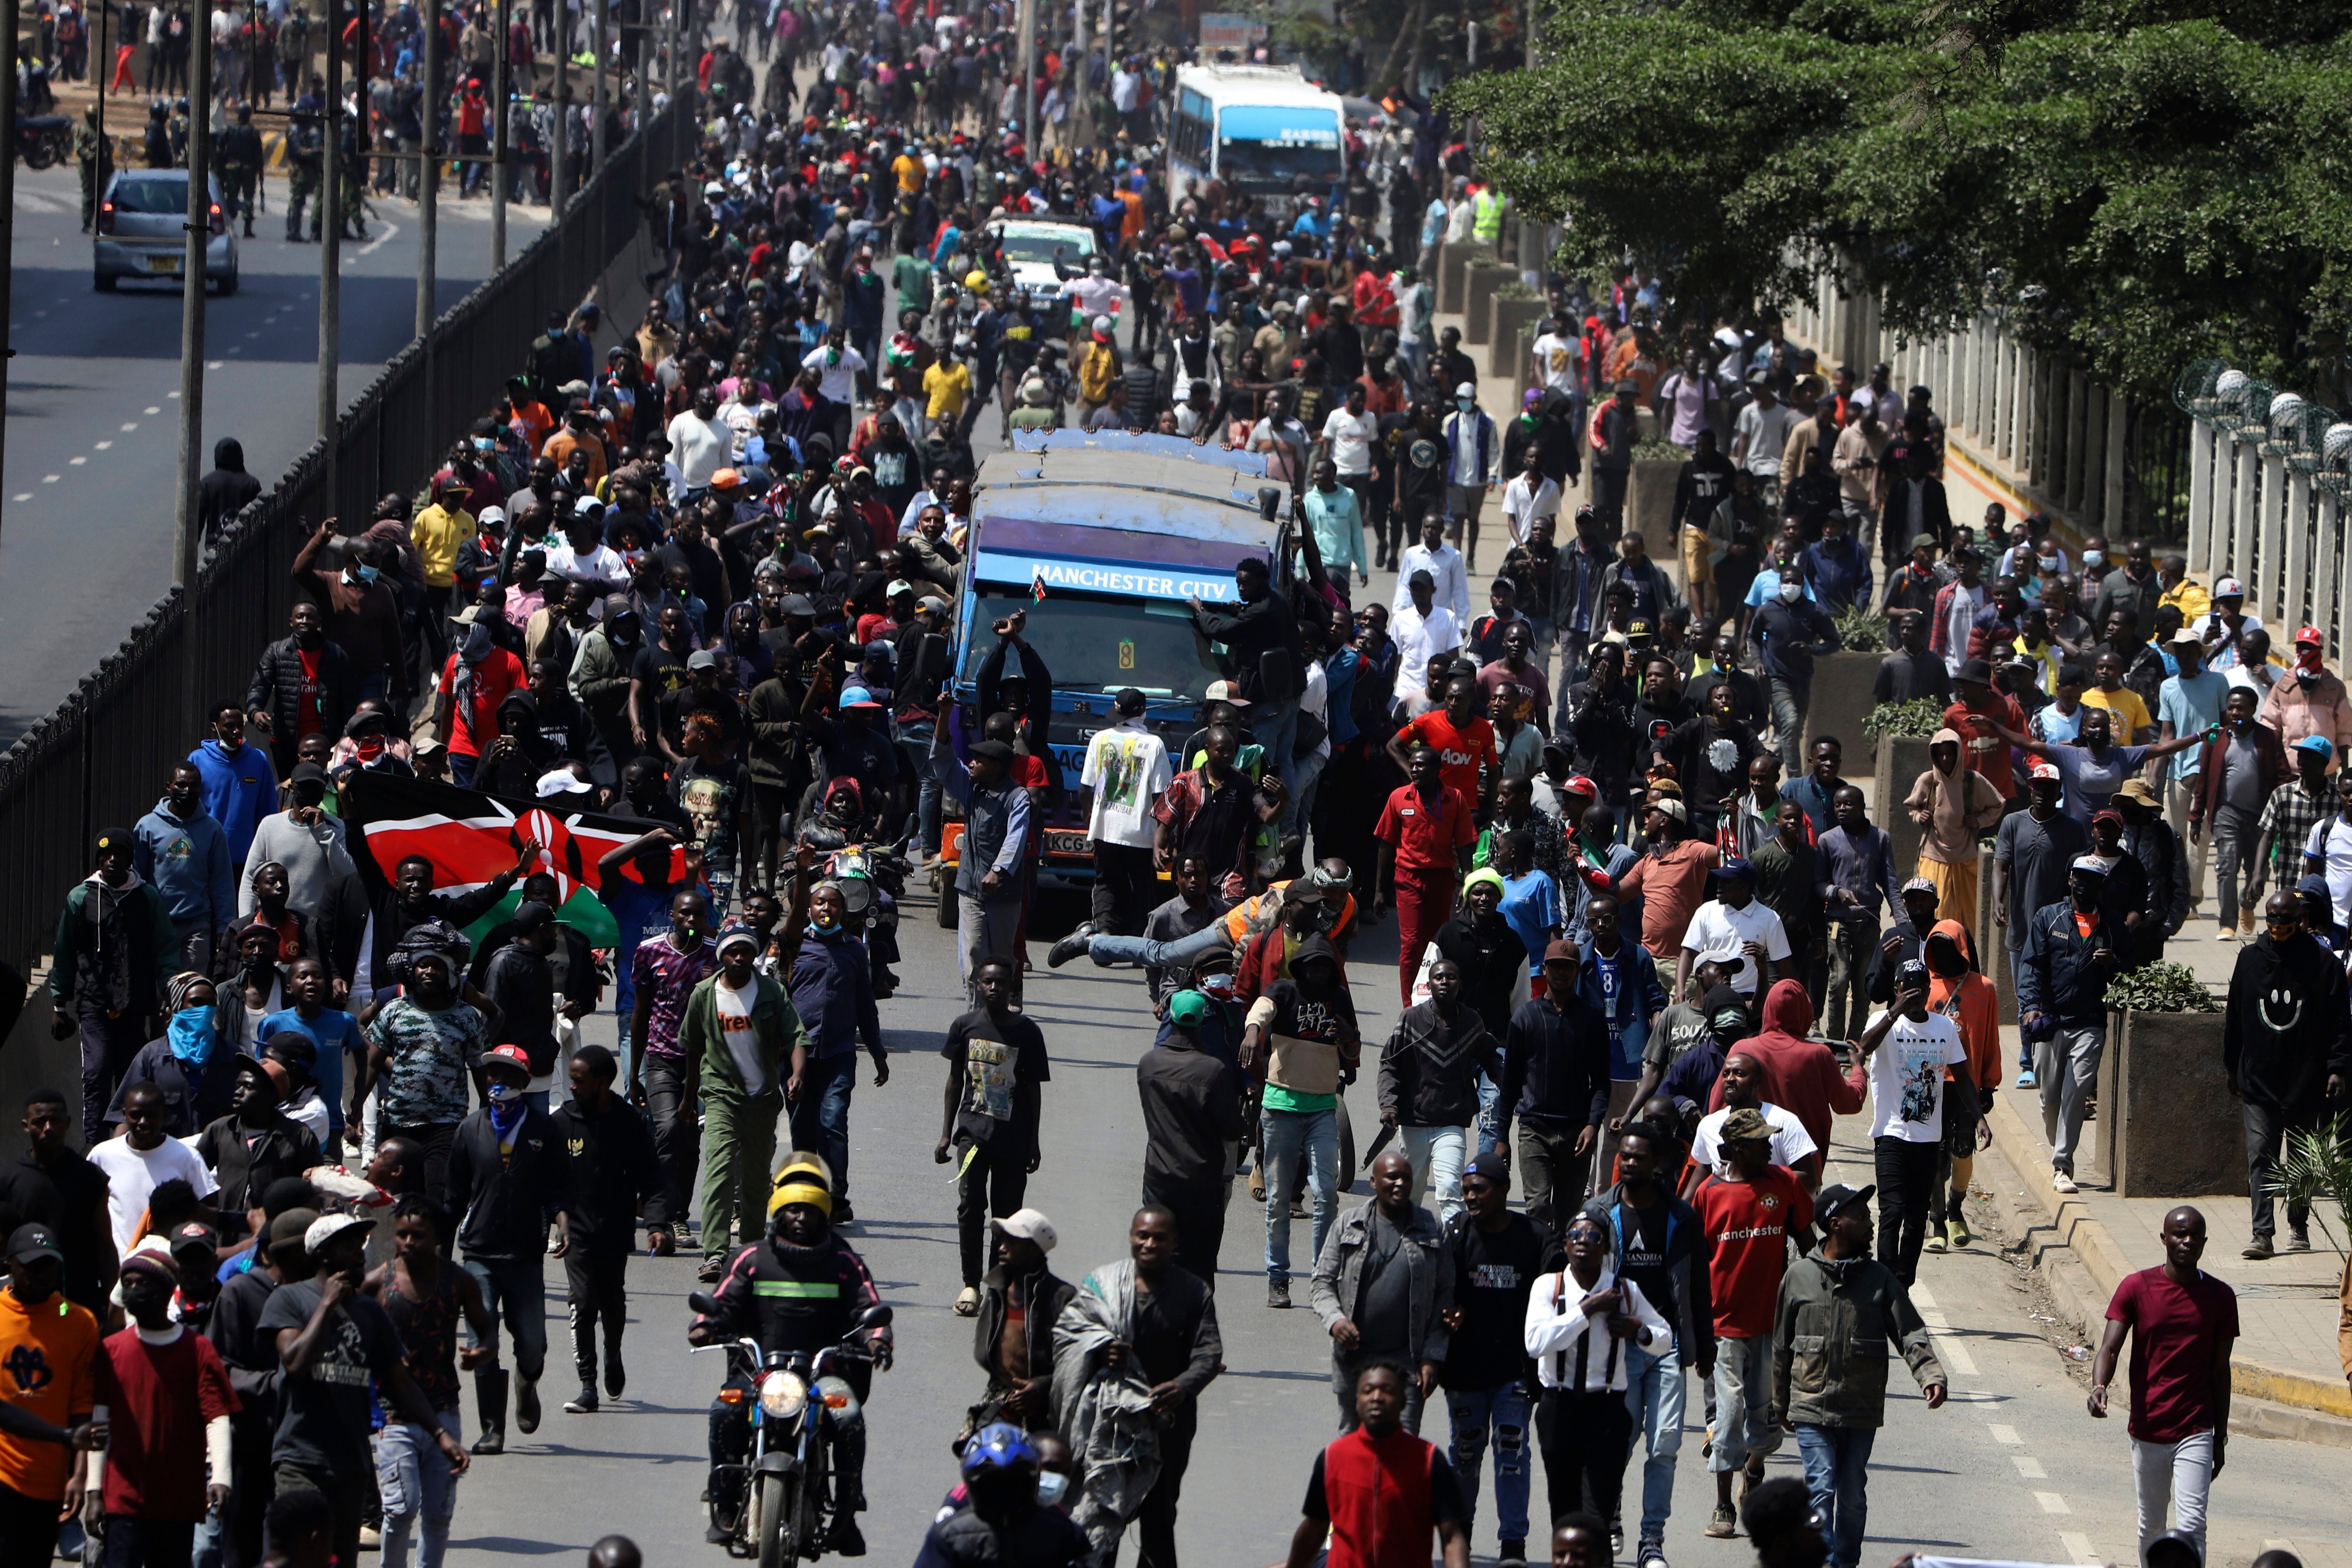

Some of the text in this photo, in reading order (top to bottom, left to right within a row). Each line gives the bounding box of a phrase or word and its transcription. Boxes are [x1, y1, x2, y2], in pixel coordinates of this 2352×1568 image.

[1031, 564, 1227, 599] MANCHESTER CITY
[1121, 645, 1131, 667] 8
[1051, 836, 1084, 851] KCG
[1603, 972, 1613, 993] 8
[969, 1038, 991, 1050] BON
